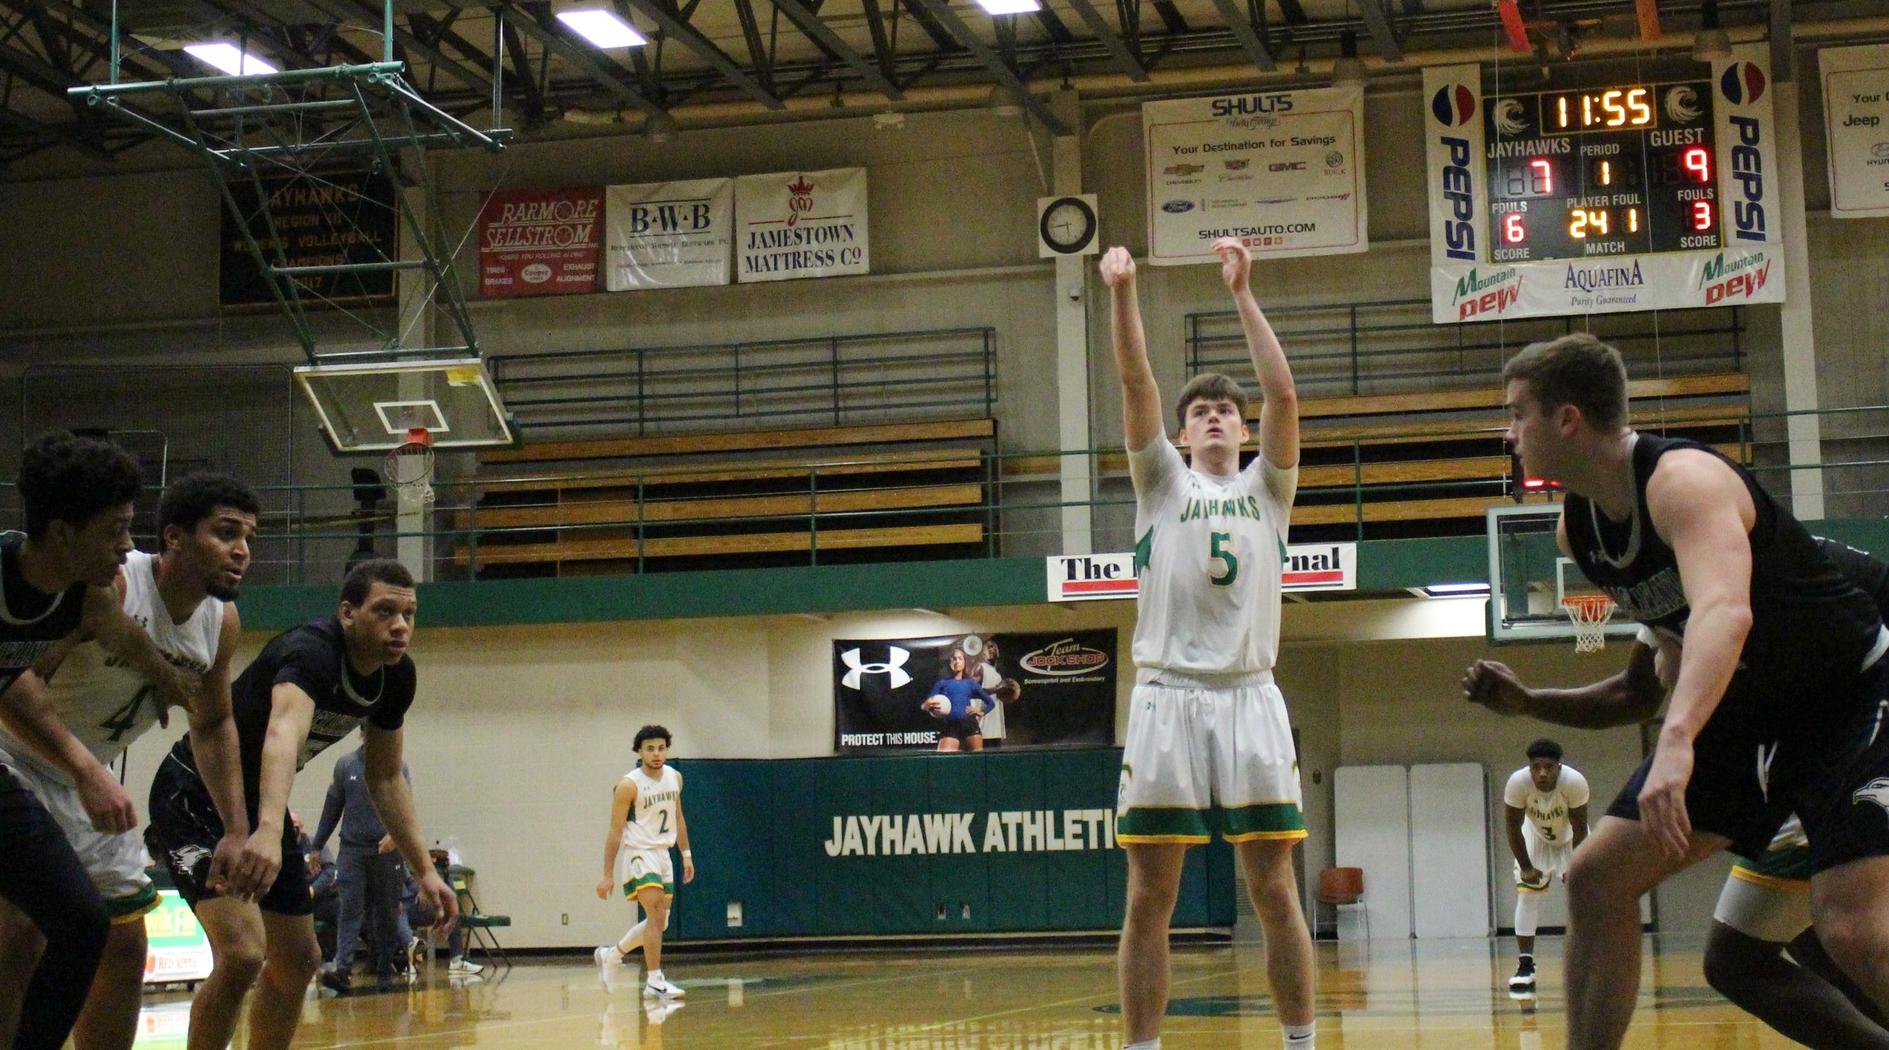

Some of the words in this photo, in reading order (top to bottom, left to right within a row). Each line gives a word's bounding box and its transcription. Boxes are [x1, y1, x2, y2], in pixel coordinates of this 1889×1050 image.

[1212, 94, 1293, 116] SHULTS
[1557, 88, 1651, 128] 11:55
[1853, 94, 1880, 103] Your
[1843, 114, 1880, 127] Jeep
[1173, 145, 1199, 155] Your
[1203, 139, 1265, 153] Destination
[1270, 138, 1285, 148] for
[1290, 135, 1336, 148] Savings
[1487, 138, 1571, 159] JAYHAWKS
[1650, 128, 1704, 147] GUEST
[1580, 143, 1620, 156] PERIOD
[1269, 161, 1306, 172] GMC
[1531, 160, 1551, 193] 7
[1602, 161, 1610, 185] 1
[1685, 149, 1709, 183] 9
[1729, 115, 1766, 242] PEPSI
[1441, 136, 1476, 260] PEPSI
[1566, 196, 1609, 209] PLAYER
[1612, 192, 1641, 206] FOUL
[1678, 188, 1714, 201] FOULS
[1492, 201, 1527, 213] FOULS
[1694, 202, 1711, 230] 3
[1199, 223, 1316, 239] SHULTSAUTO.COM
[1505, 214, 1525, 243] 6
[1569, 210, 1608, 239] 24
[1628, 208, 1637, 233] 1
[487, 225, 593, 248] SELLSTROM
[748, 224, 855, 249] JAMESTOWN
[1586, 241, 1625, 254] MATCH
[1681, 235, 1717, 248] SCORE
[746, 248, 835, 273] MATTRESS
[1494, 247, 1530, 261] SCORE
[1564, 259, 1644, 292] AQUAFINA
[1699, 252, 1764, 290] Mountain
[1452, 267, 1516, 306] Mountain
[1570, 296, 1598, 307] Purity
[1061, 557, 1121, 580] The
[1210, 531, 1238, 586] 5
[99, 685, 157, 741] 4
[841, 733, 884, 746] PROTECT
[886, 732, 903, 745] THIS
[658, 809, 669, 834] 2
[824, 813, 976, 857] JAYHAWK
[983, 808, 1113, 853] ATHLETI
